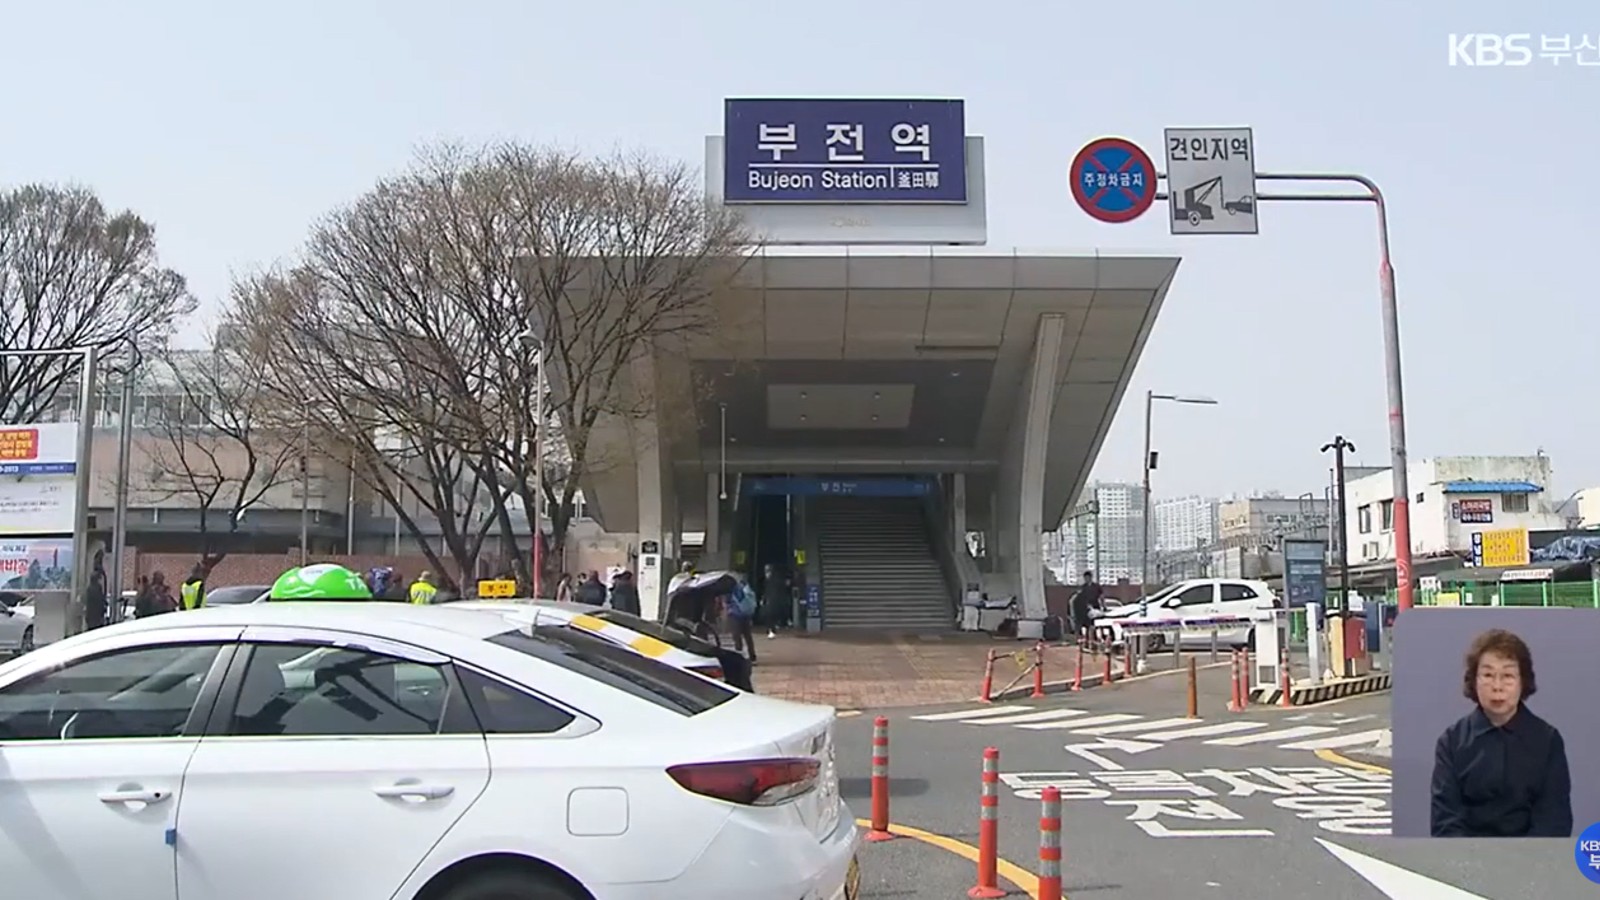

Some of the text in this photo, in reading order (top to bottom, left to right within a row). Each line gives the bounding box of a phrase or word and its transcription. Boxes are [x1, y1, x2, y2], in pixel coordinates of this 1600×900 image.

[1169, 137, 1249, 161] 견인지역
[749, 171, 887, 190] Bujeon Station
[1084, 172, 1143, 186] 주정차금지
